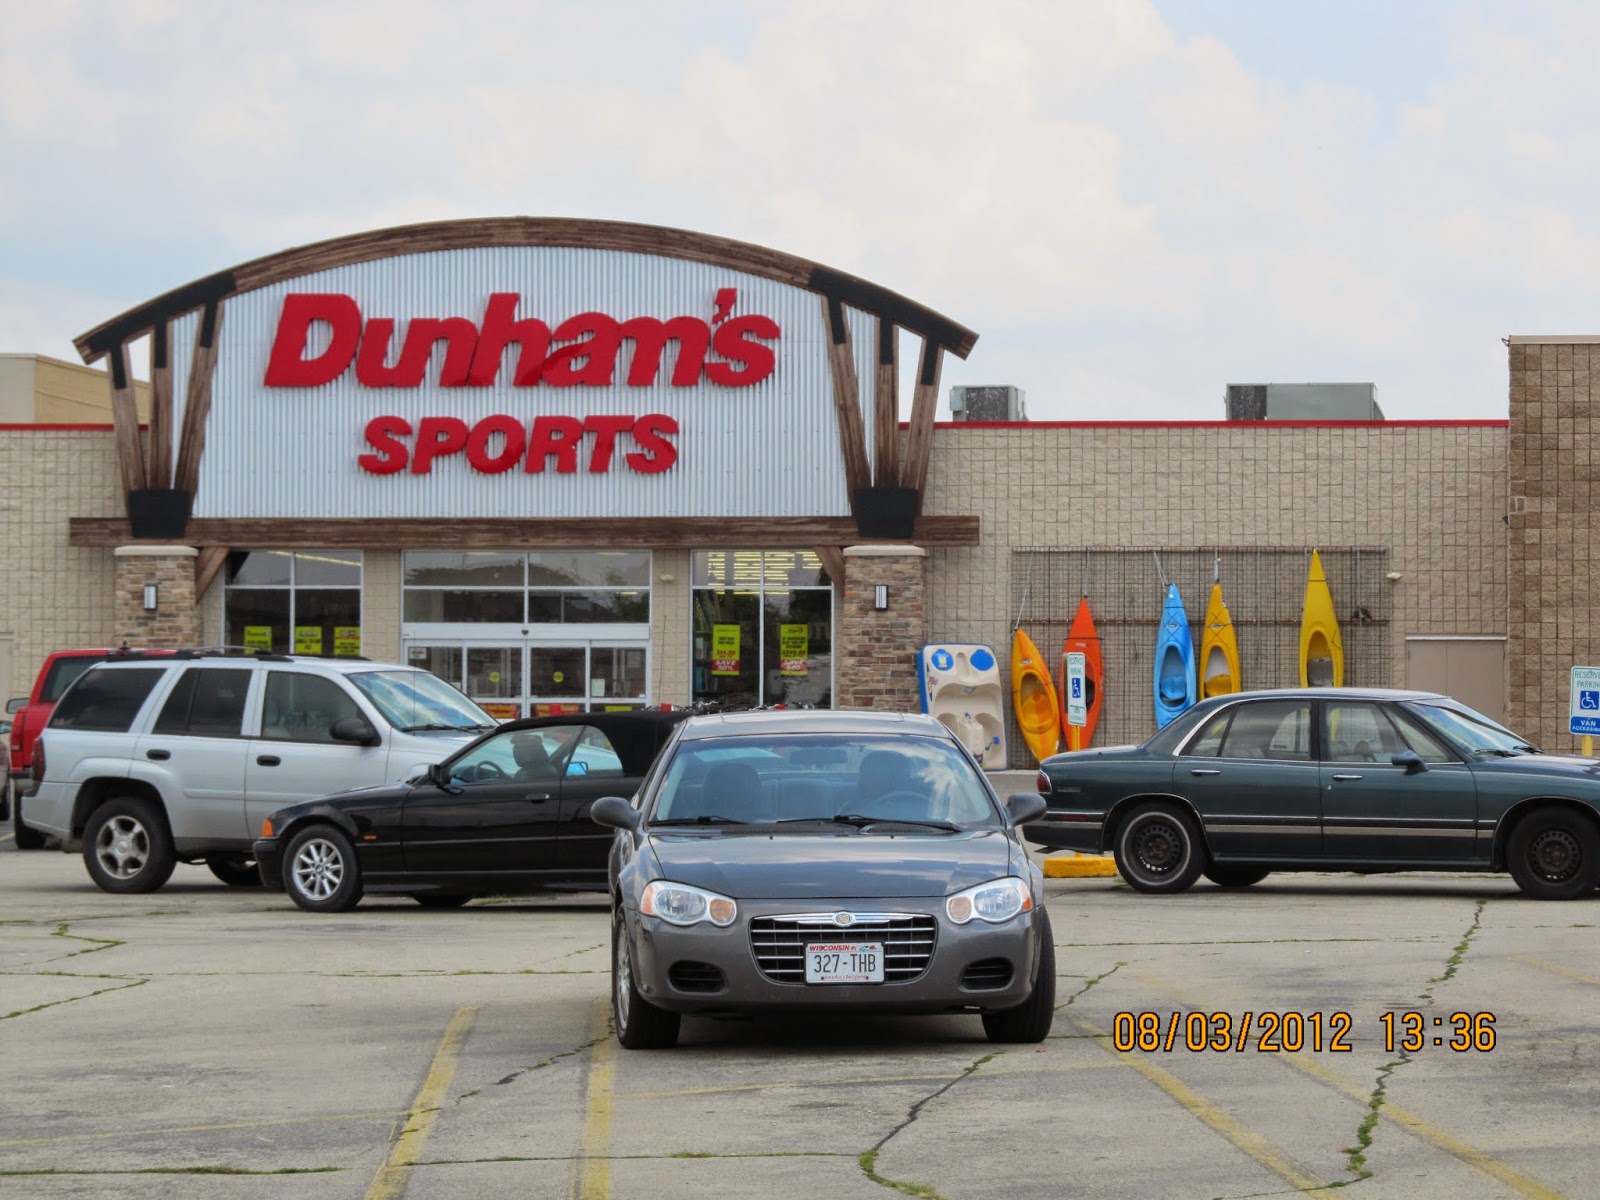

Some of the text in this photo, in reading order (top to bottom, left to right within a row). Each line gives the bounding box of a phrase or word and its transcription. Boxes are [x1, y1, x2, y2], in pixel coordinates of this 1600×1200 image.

[264, 288, 781, 388] Dunham's
[358, 413, 679, 474] SPORTS
[813, 953, 876, 973] 327-THB
